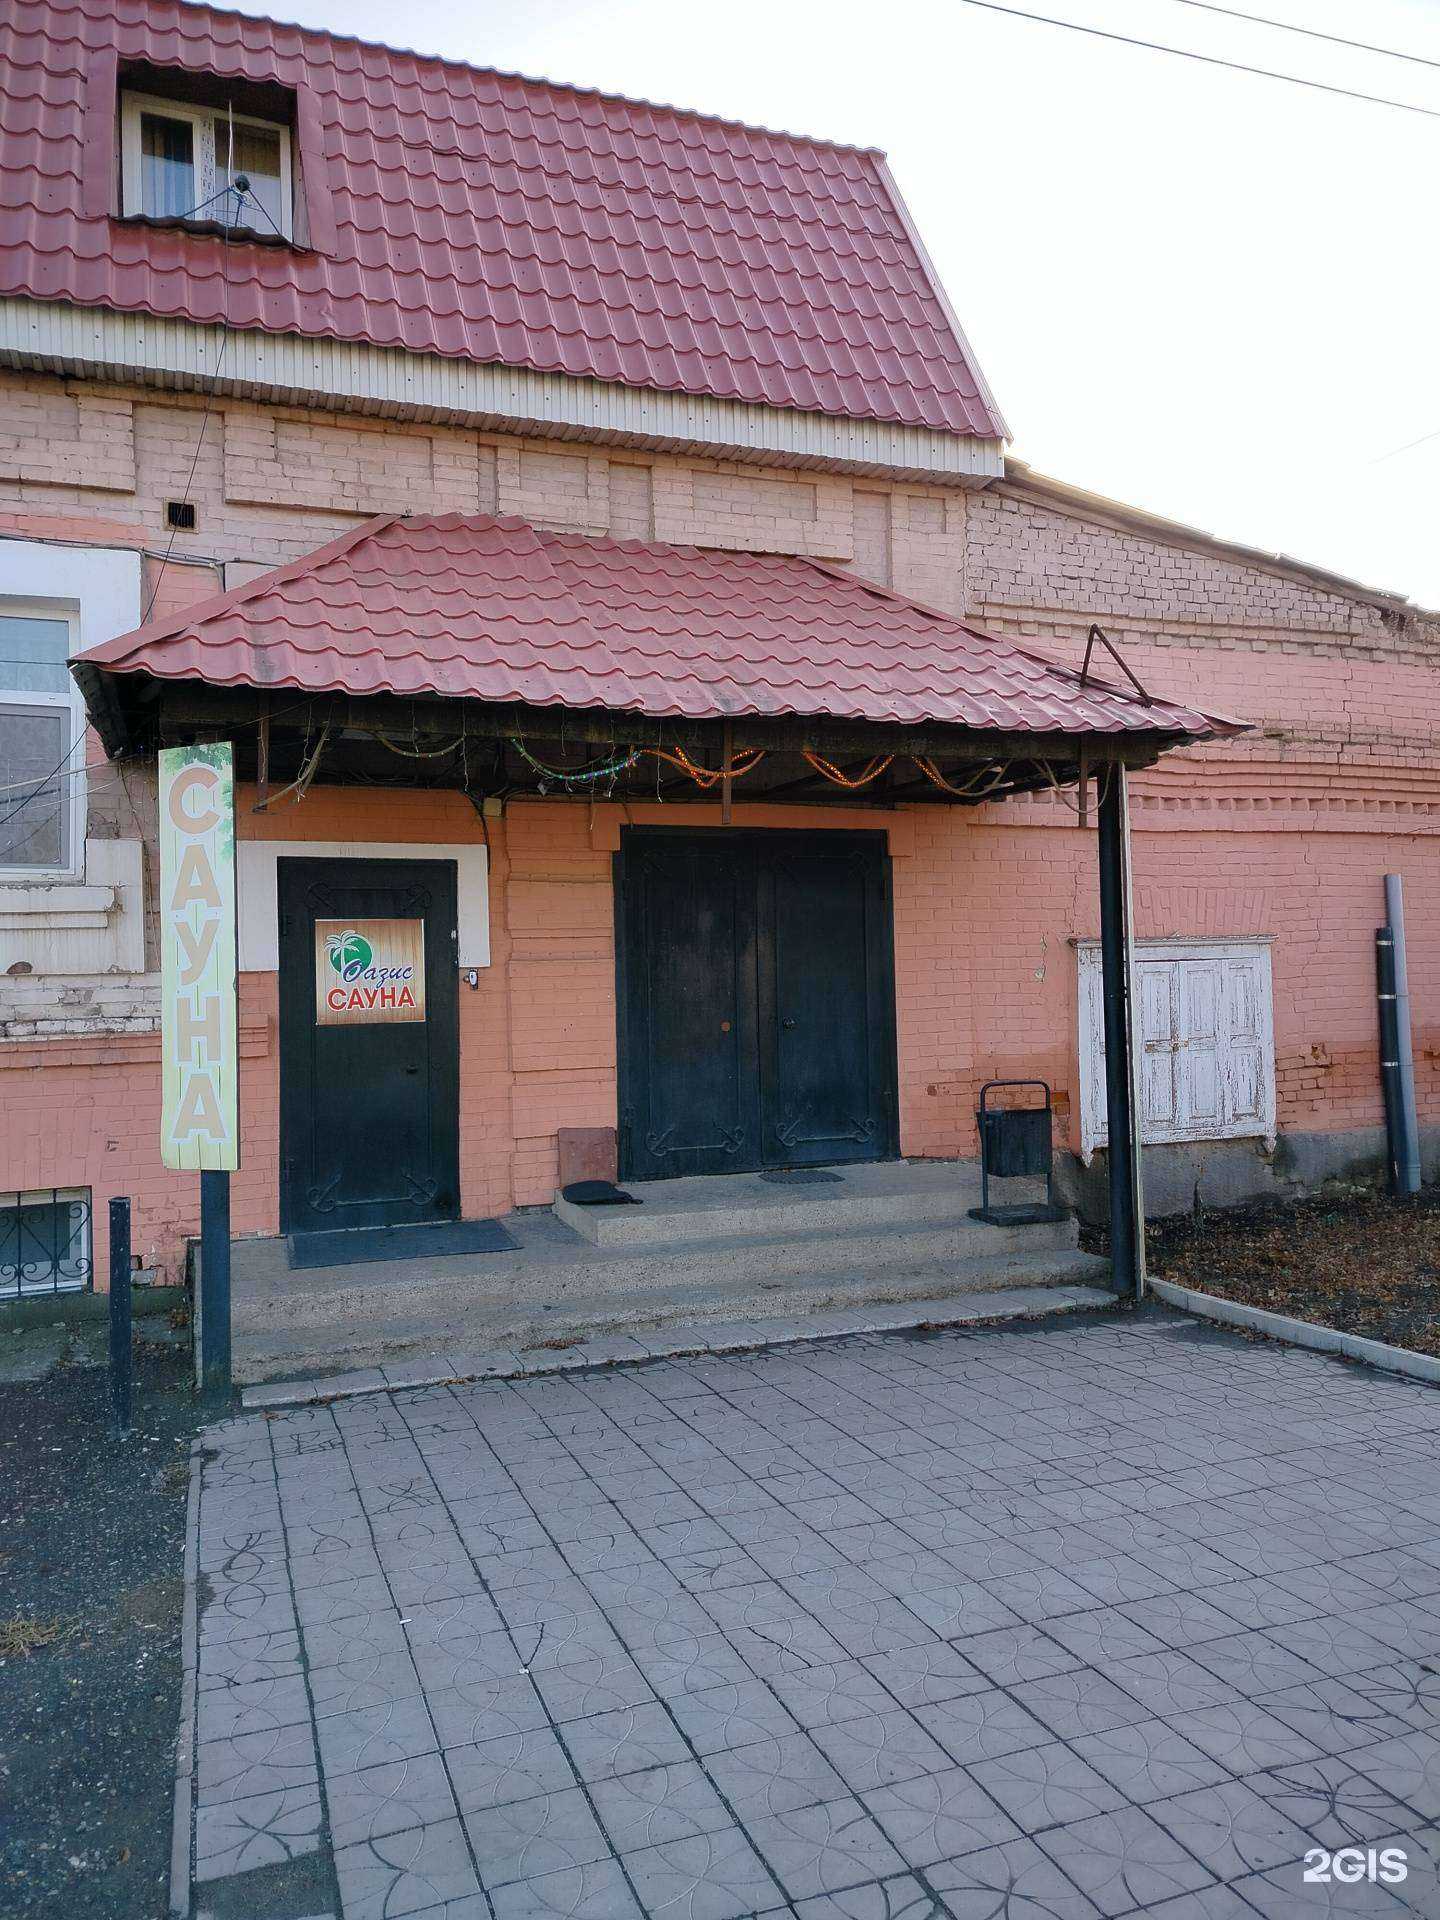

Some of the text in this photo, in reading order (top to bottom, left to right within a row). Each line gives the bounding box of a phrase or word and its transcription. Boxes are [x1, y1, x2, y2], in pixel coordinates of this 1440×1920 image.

[168, 765, 227, 1140] САУНА
[342, 959, 413, 988] Оазис
[327, 986, 415, 1011] САУНА
